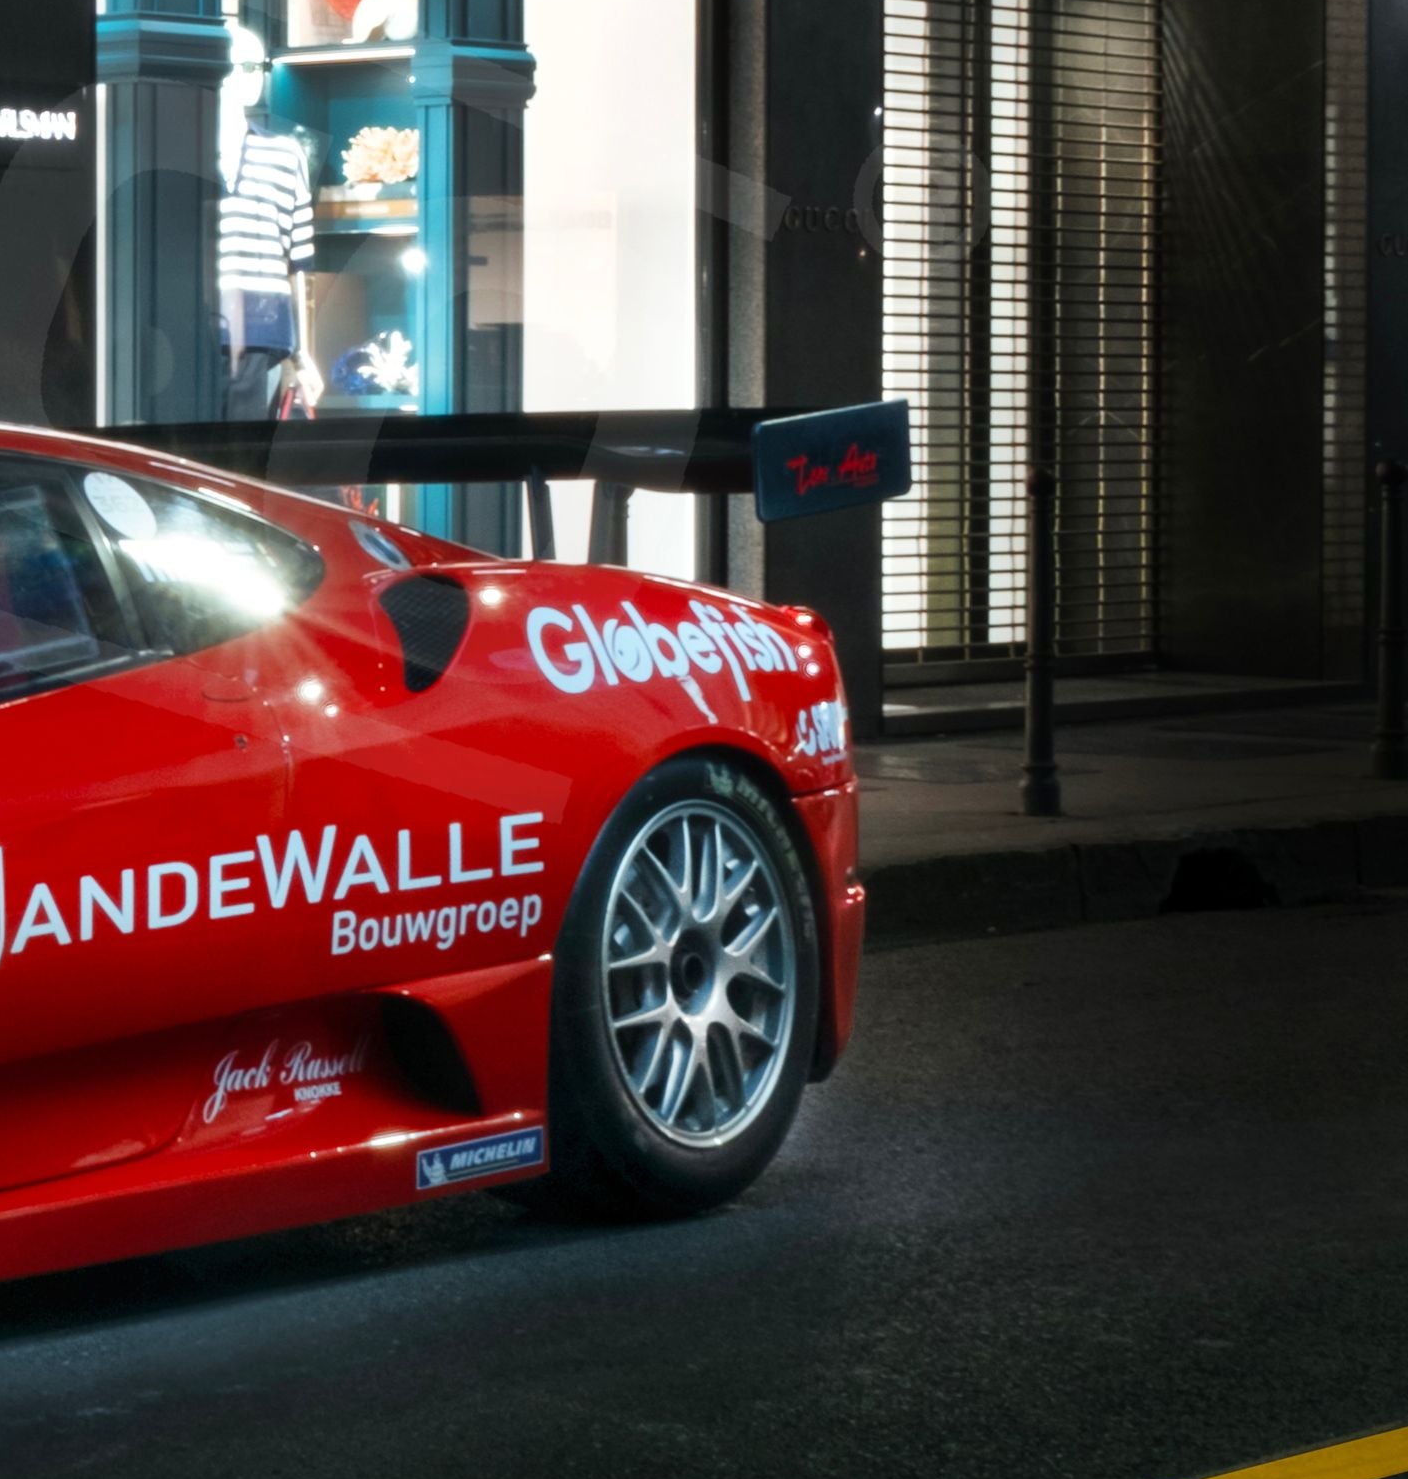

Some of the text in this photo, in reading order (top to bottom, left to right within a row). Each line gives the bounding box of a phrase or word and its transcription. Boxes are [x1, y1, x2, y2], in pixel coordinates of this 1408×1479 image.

[526, 599, 798, 702] Globefish
[331, 893, 543, 955] Bouwgroep
[202, 1038, 274, 1124] Jack
[449, 1135, 537, 1172] MICHELIN
